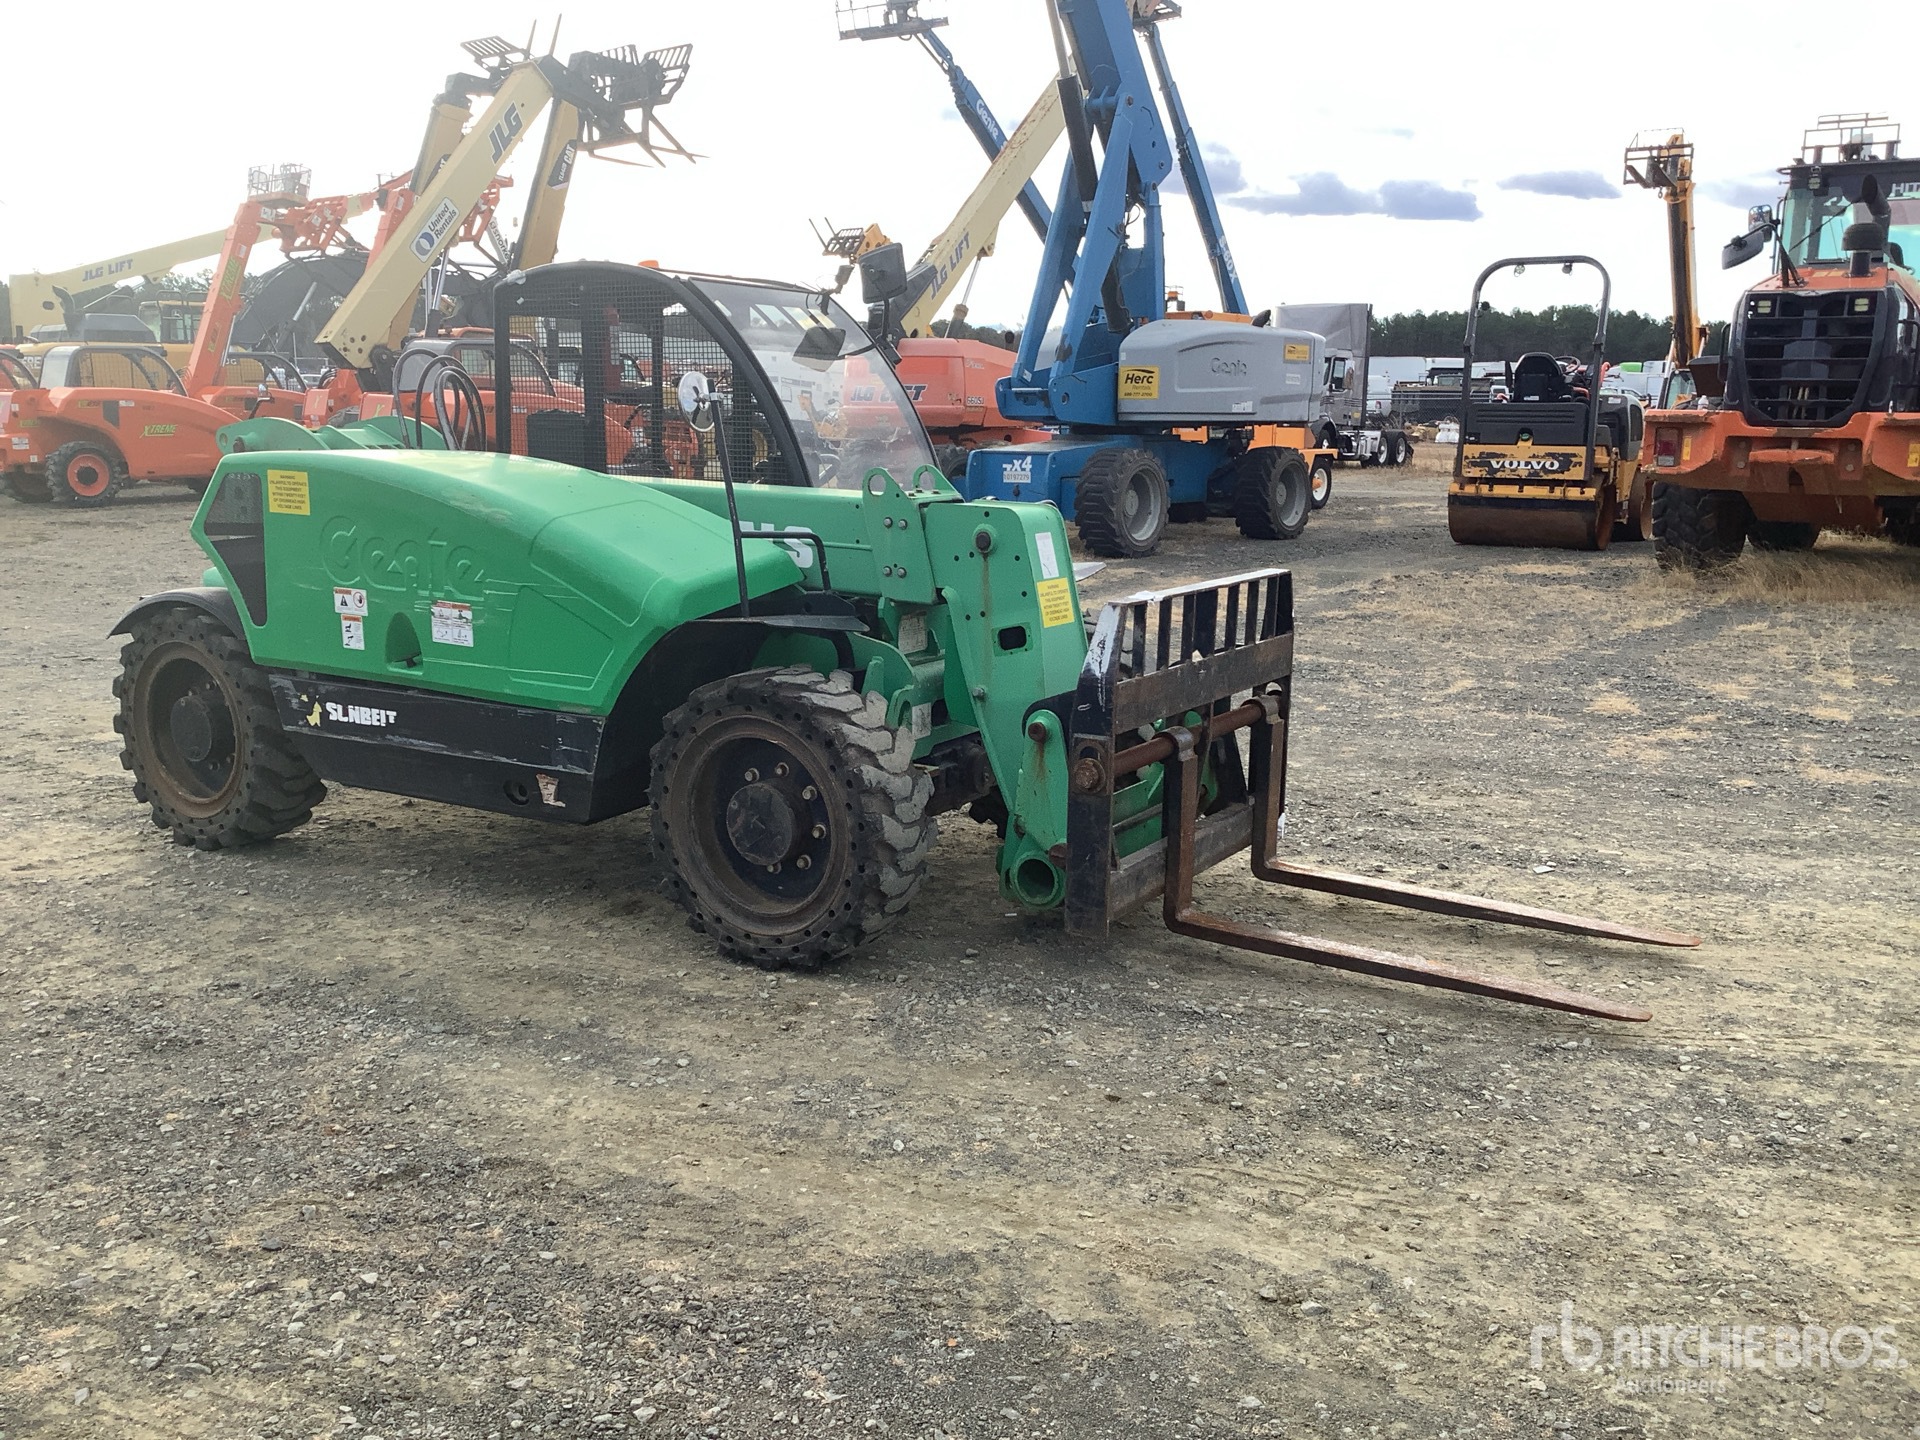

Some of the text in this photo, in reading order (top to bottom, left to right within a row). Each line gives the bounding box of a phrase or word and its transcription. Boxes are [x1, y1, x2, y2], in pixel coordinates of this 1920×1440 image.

[489, 101, 523, 165] JLG
[976, 99, 999, 140] Genie
[563, 144, 577, 165] CAT
[428, 203, 450, 232] United
[434, 209, 457, 239] Rentals
[490, 227, 511, 261] snorke
[82, 259, 133, 282] JLG LIFT
[931, 231, 971, 300] JLG LIFT
[1124, 373, 1155, 385] Herc
[1210, 357, 1248, 377] Genie
[850, 386, 876, 402] JLG
[1489, 459, 1560, 470] VOLVO
[319, 515, 485, 601] Genie
